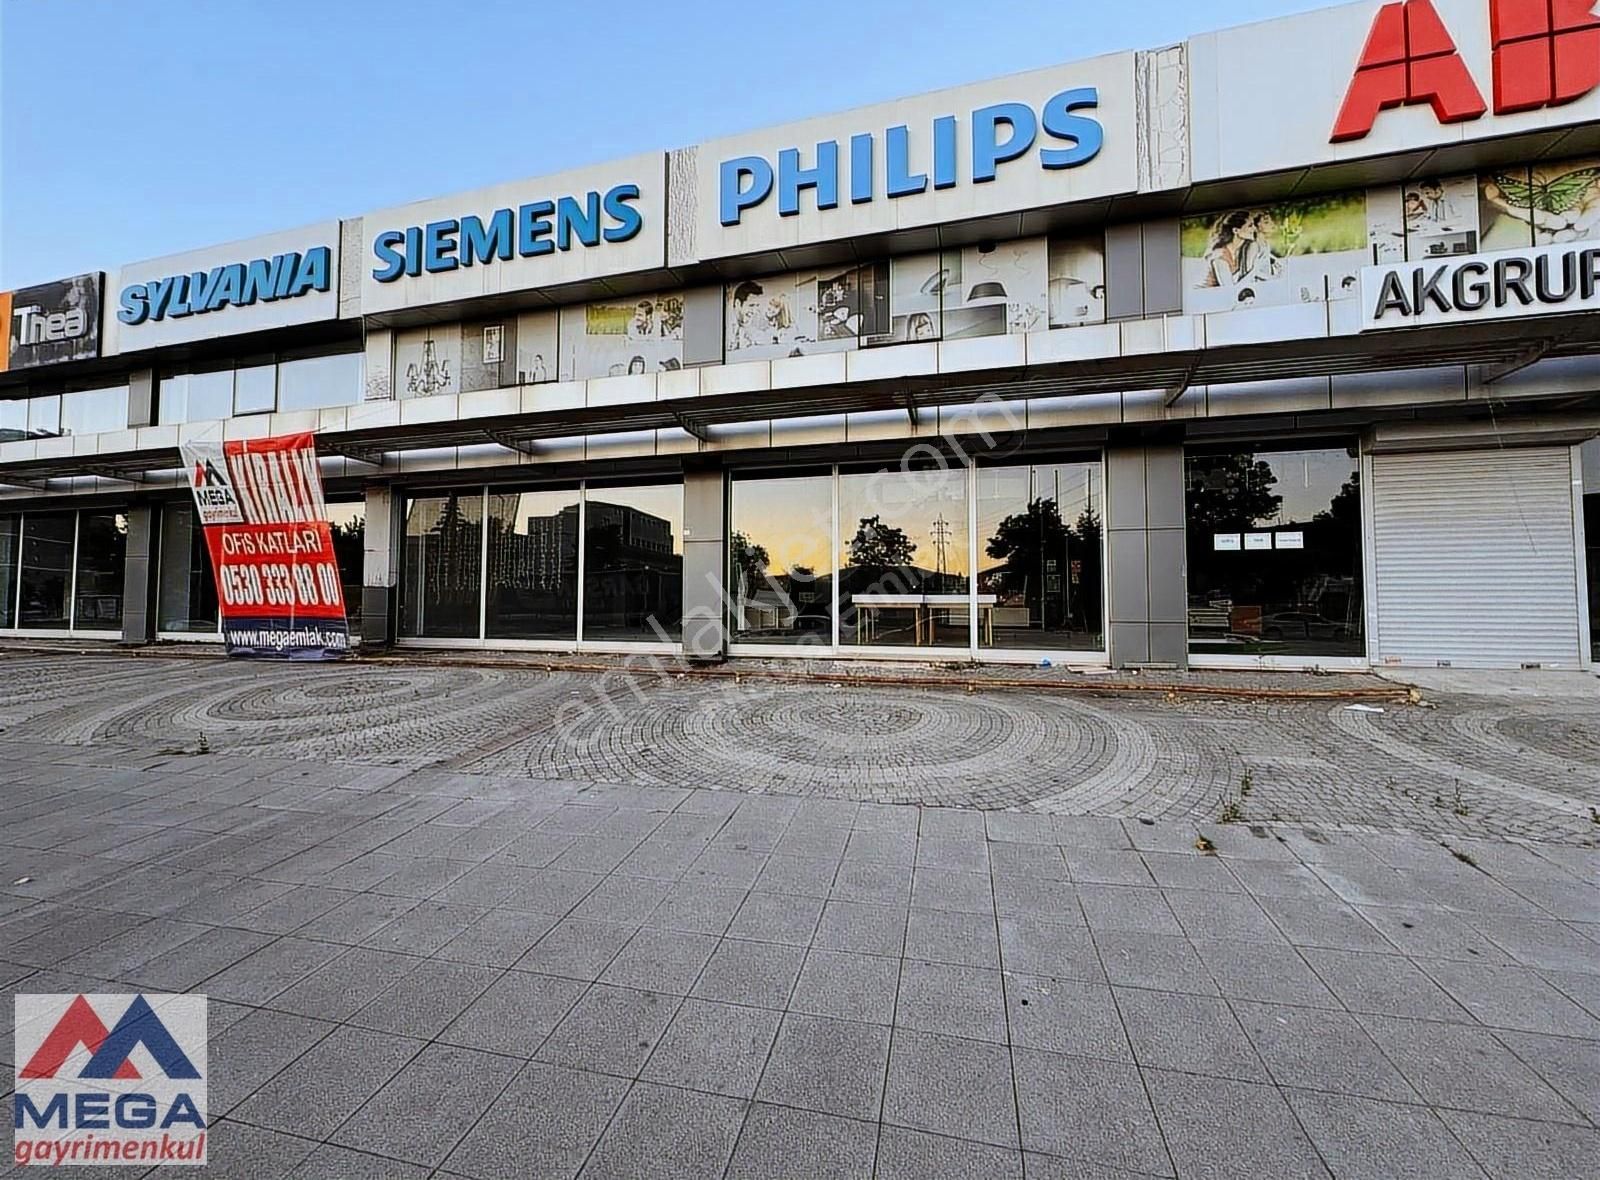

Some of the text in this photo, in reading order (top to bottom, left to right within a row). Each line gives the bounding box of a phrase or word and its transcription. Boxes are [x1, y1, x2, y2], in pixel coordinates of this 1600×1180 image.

[720, 87, 1105, 226] PHILIPS
[372, 184, 643, 283] SIEMENS
[118, 246, 331, 325] SYLVANIA
[14, 305, 87, 345] Thea
[196, 488, 237, 506] MEGA
[220, 564, 264, 606] 0530
[262, 564, 295, 606] 333
[317, 563, 340, 606] 00
[229, 627, 347, 651] www.megaemlak.com
